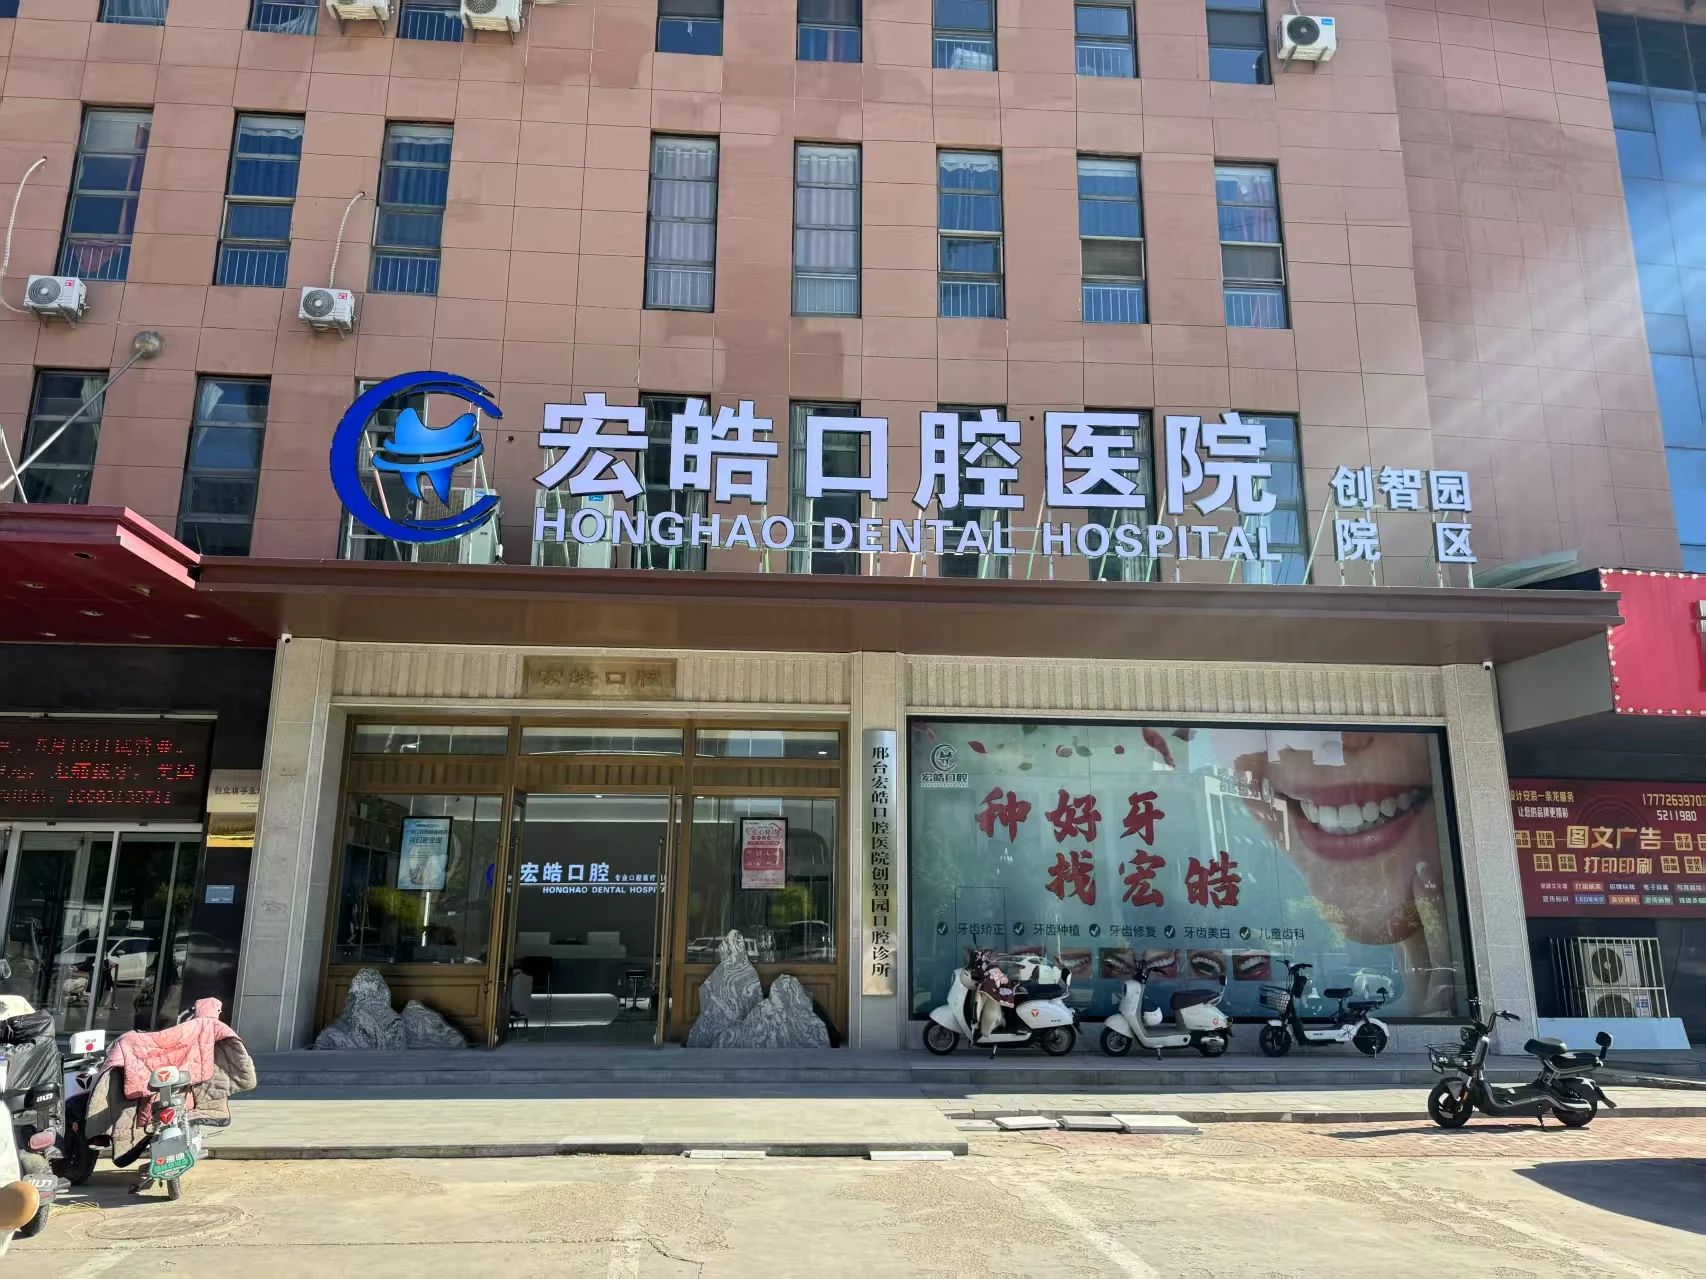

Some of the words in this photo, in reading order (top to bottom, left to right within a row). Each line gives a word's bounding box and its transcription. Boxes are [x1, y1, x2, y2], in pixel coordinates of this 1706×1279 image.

[534, 392, 1277, 516] 宏皓口腔医院
[1332, 464, 1473, 512] 创智园
[533, 507, 796, 549] HONGHAO
[824, 516, 1017, 556] DENTAL
[1042, 522, 1284, 562] HOSPITAL
[975, 786, 1166, 845] 种好牙
[1517, 806, 1569, 818] 让您的品牌更精彩
[1656, 809, 1698, 822] 5211980
[1566, 825, 1662, 850] 图文广告
[520, 861, 610, 883] 宏皓口腔
[870, 746, 890, 978] 邢台宏皓口腔医院创智园口腔诊所
[1583, 856, 1653, 875] 打印印刷
[542, 886, 588, 894] HONGHAO
[592, 886, 626, 894] DENTAL
[629, 886, 666, 894] HOSPIA
[1045, 849, 1242, 909] 找宏皓
[956, 922, 1004, 936] 牙齿矫正
[1033, 923, 1081, 937] 牙齿种植
[1109, 924, 1157, 938] 牙齿修复
[1183, 926, 1231, 940] 牙齿美白
[1258, 927, 1306, 941] 儿童齿科
